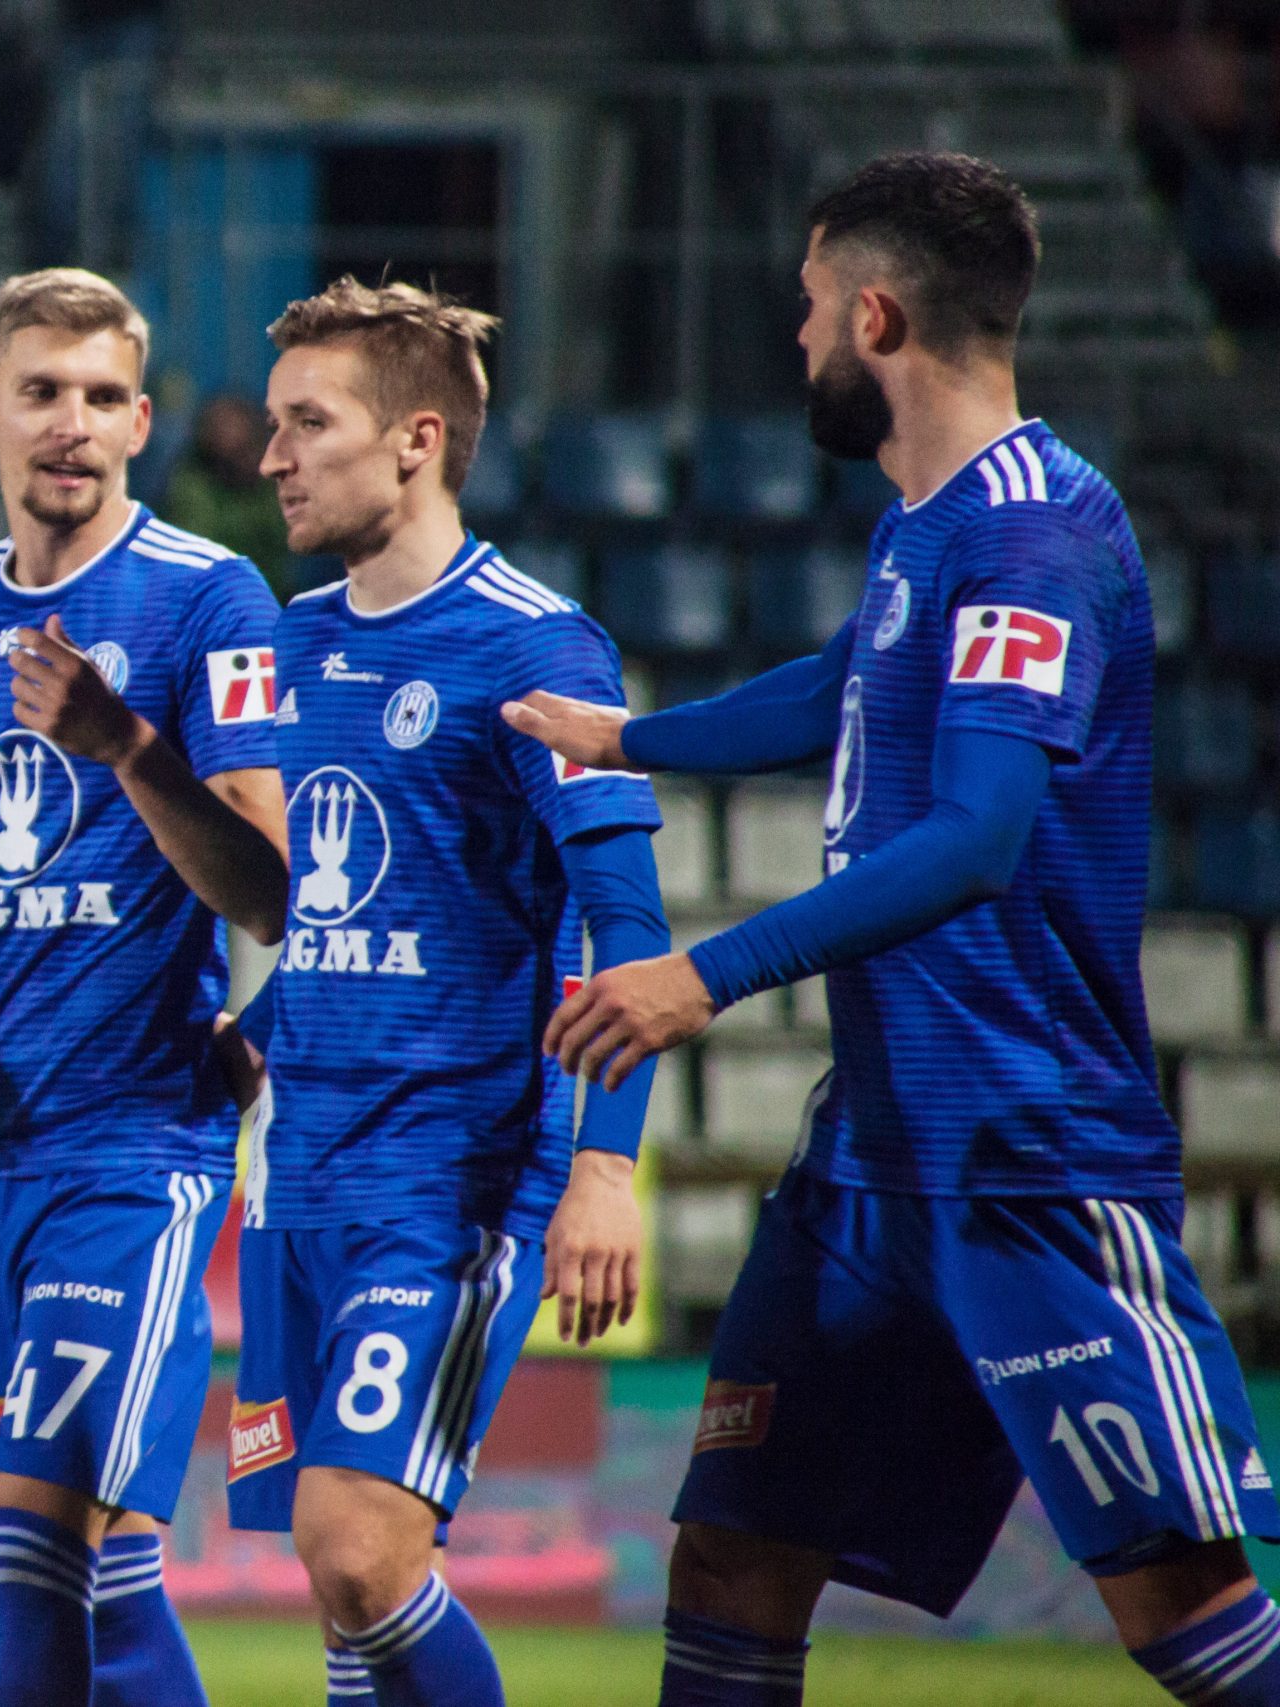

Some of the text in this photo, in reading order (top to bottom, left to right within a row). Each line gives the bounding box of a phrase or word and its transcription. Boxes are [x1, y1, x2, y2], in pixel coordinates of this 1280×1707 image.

[280, 928, 427, 975] IGMA
[62, 1282, 125, 1308] SPORT
[368, 1286, 434, 1307] SPORT
[997, 1336, 1113, 1378] LION SPORT
[3, 1340, 113, 1440] 47
[337, 1332, 409, 1434] 8
[1049, 1402, 1160, 1506] 10
